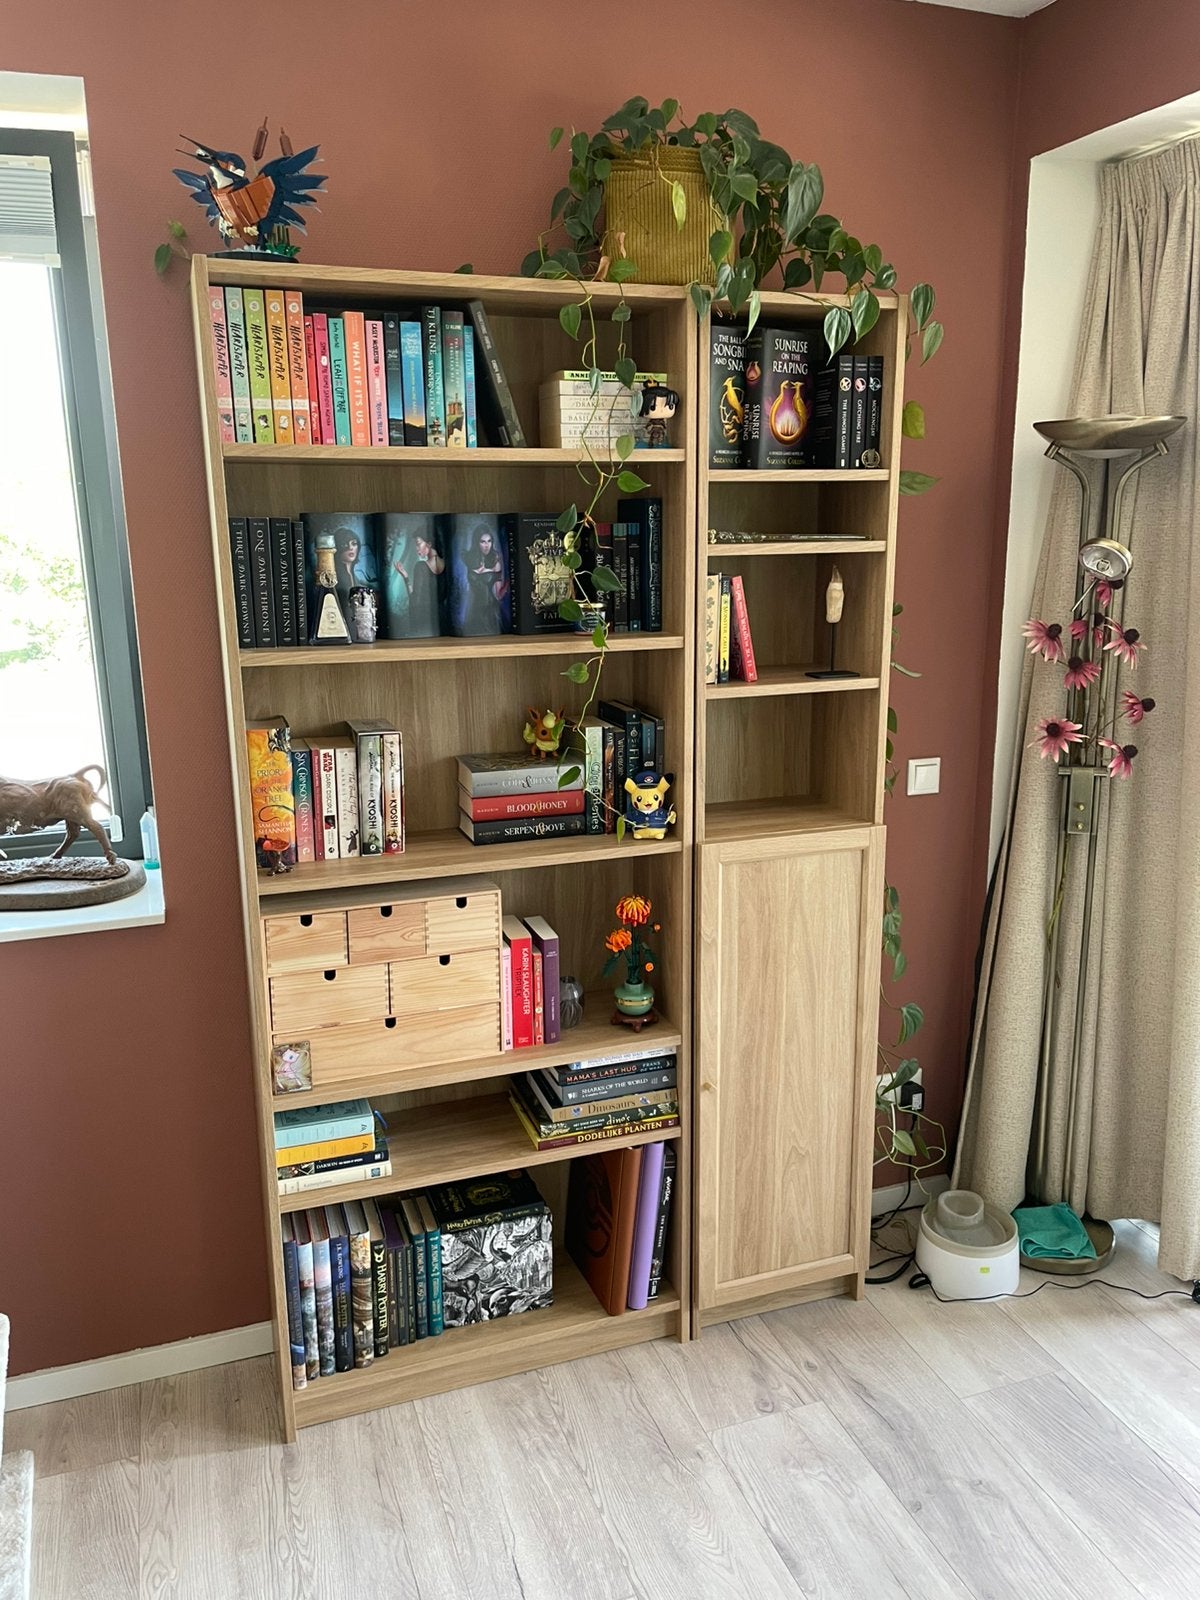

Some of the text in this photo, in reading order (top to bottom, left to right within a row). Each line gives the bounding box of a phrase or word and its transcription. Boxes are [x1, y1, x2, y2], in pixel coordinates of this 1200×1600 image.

[427, 308, 438, 356] TJ KLUNE
[718, 334, 743, 344] THE BALL
[212, 322, 228, 378] HEARTSTOPPER
[230, 322, 244, 378] HEARTSTOPPER
[250, 323, 265, 379] HEARTSTOPPER
[270, 325, 286, 381] HEARTSTOPPER
[289, 325, 303, 381] HEARTSTOPPER
[352, 341, 360, 372] WHAT
[713, 344, 748, 358] SONGBI
[774, 338, 808, 354] SUNRISE
[791, 354, 800, 362] THE
[728, 359, 744, 372] SNA
[772, 361, 808, 375] REAPING
[354, 374, 361, 386] IF
[356, 390, 364, 406] IT'S
[356, 410, 364, 424] US
[752, 404, 760, 440] SUNRISE
[295, 539, 304, 572] QUEENS
[235, 530, 250, 634] THREE DARK CROWNS
[254, 530, 270, 634] ONE DARK THRONE
[278, 530, 290, 634] TWO DARK REIGNS
[590, 762, 600, 786] City
[294, 752, 310, 832] SIX CRIMSON CRANES
[368, 799, 377, 830] KYOSHI
[390, 799, 398, 828] KYOSHI
[506, 803, 536, 813] BLOOD
[540, 800, 568, 810] HONEY
[591, 798, 601, 830] Bones
[504, 826, 538, 836] SERPENT
[544, 822, 566, 832] DOVE
[522, 948, 531, 1014] KARIN SLAUGHTER
[566, 1065, 638, 1082] MAMA'S LAST HUG
[582, 1086, 606, 1094] SHARKS
[627, 1078, 648, 1087] WORLD
[588, 1100, 636, 1114] Dinosaurs
[606, 1114, 631, 1126] dino's
[577, 1122, 662, 1142] DODELIJKE PLANTEN
[663, 1176, 673, 1206] AVATAR
[336, 1253, 345, 1279] ROWLING
[339, 1282, 347, 1304] HARRY
[377, 1264, 388, 1332] HARRY POTTER
